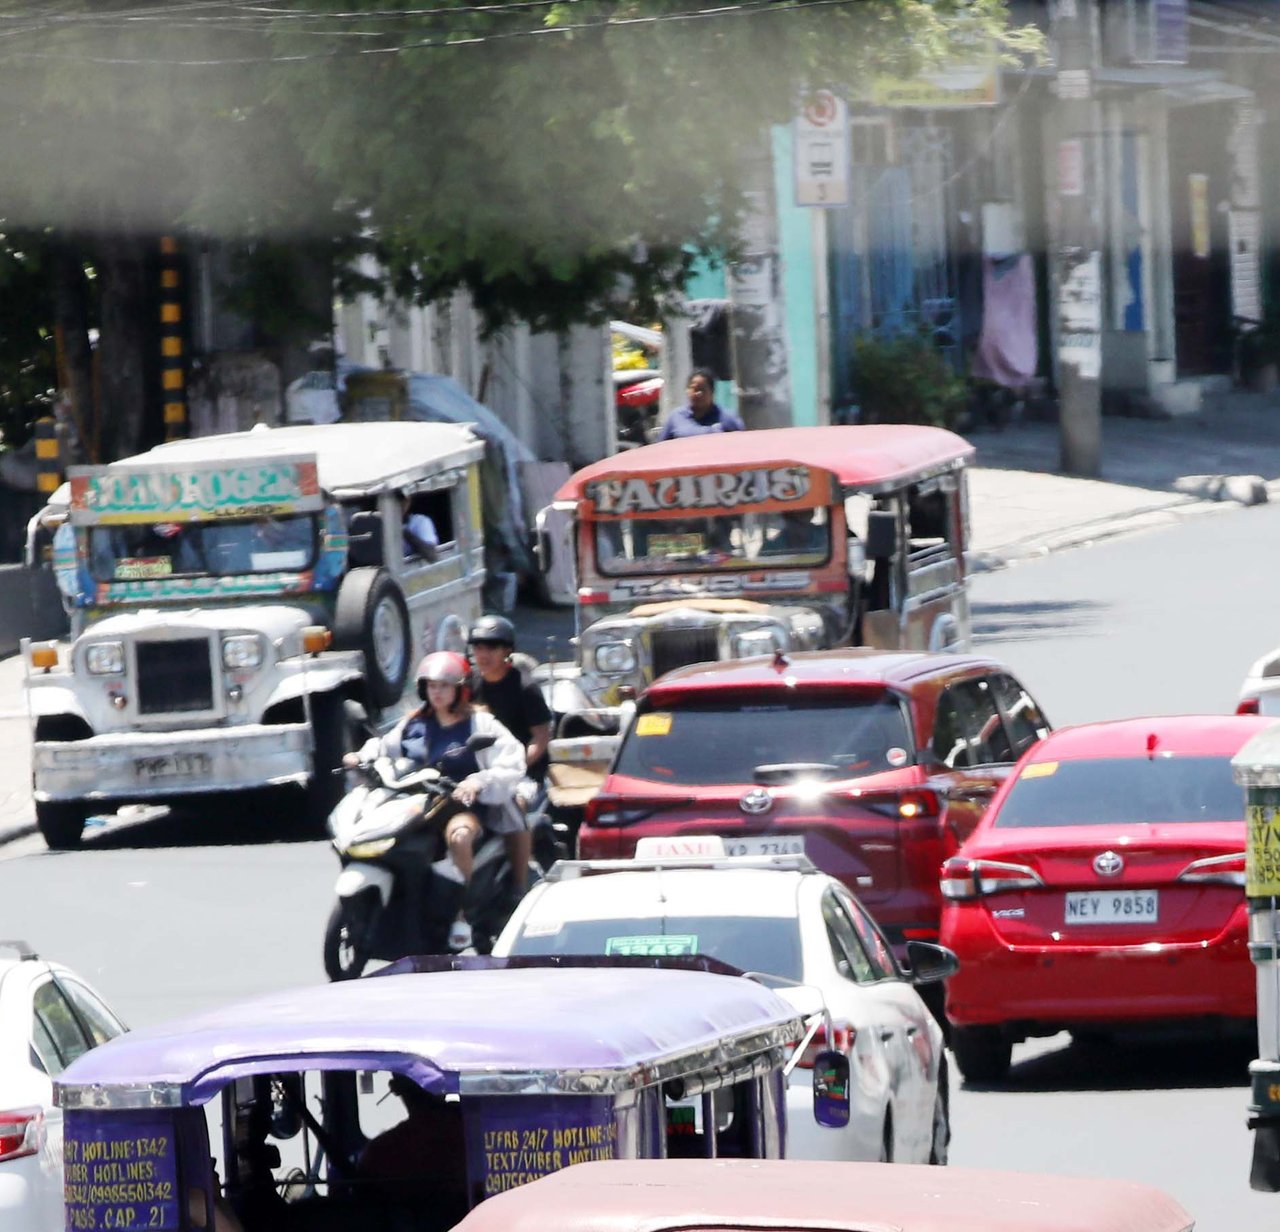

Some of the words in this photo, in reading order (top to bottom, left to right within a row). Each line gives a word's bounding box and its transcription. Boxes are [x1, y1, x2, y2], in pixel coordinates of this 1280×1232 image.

[588, 466, 812, 513] TAURUS
[1068, 899, 1101, 916] NEY
[485, 1130, 519, 1149] LTFRB
[522, 1127, 549, 1151] 24/7
[486, 1150, 563, 1171] TEXT/VIBER
